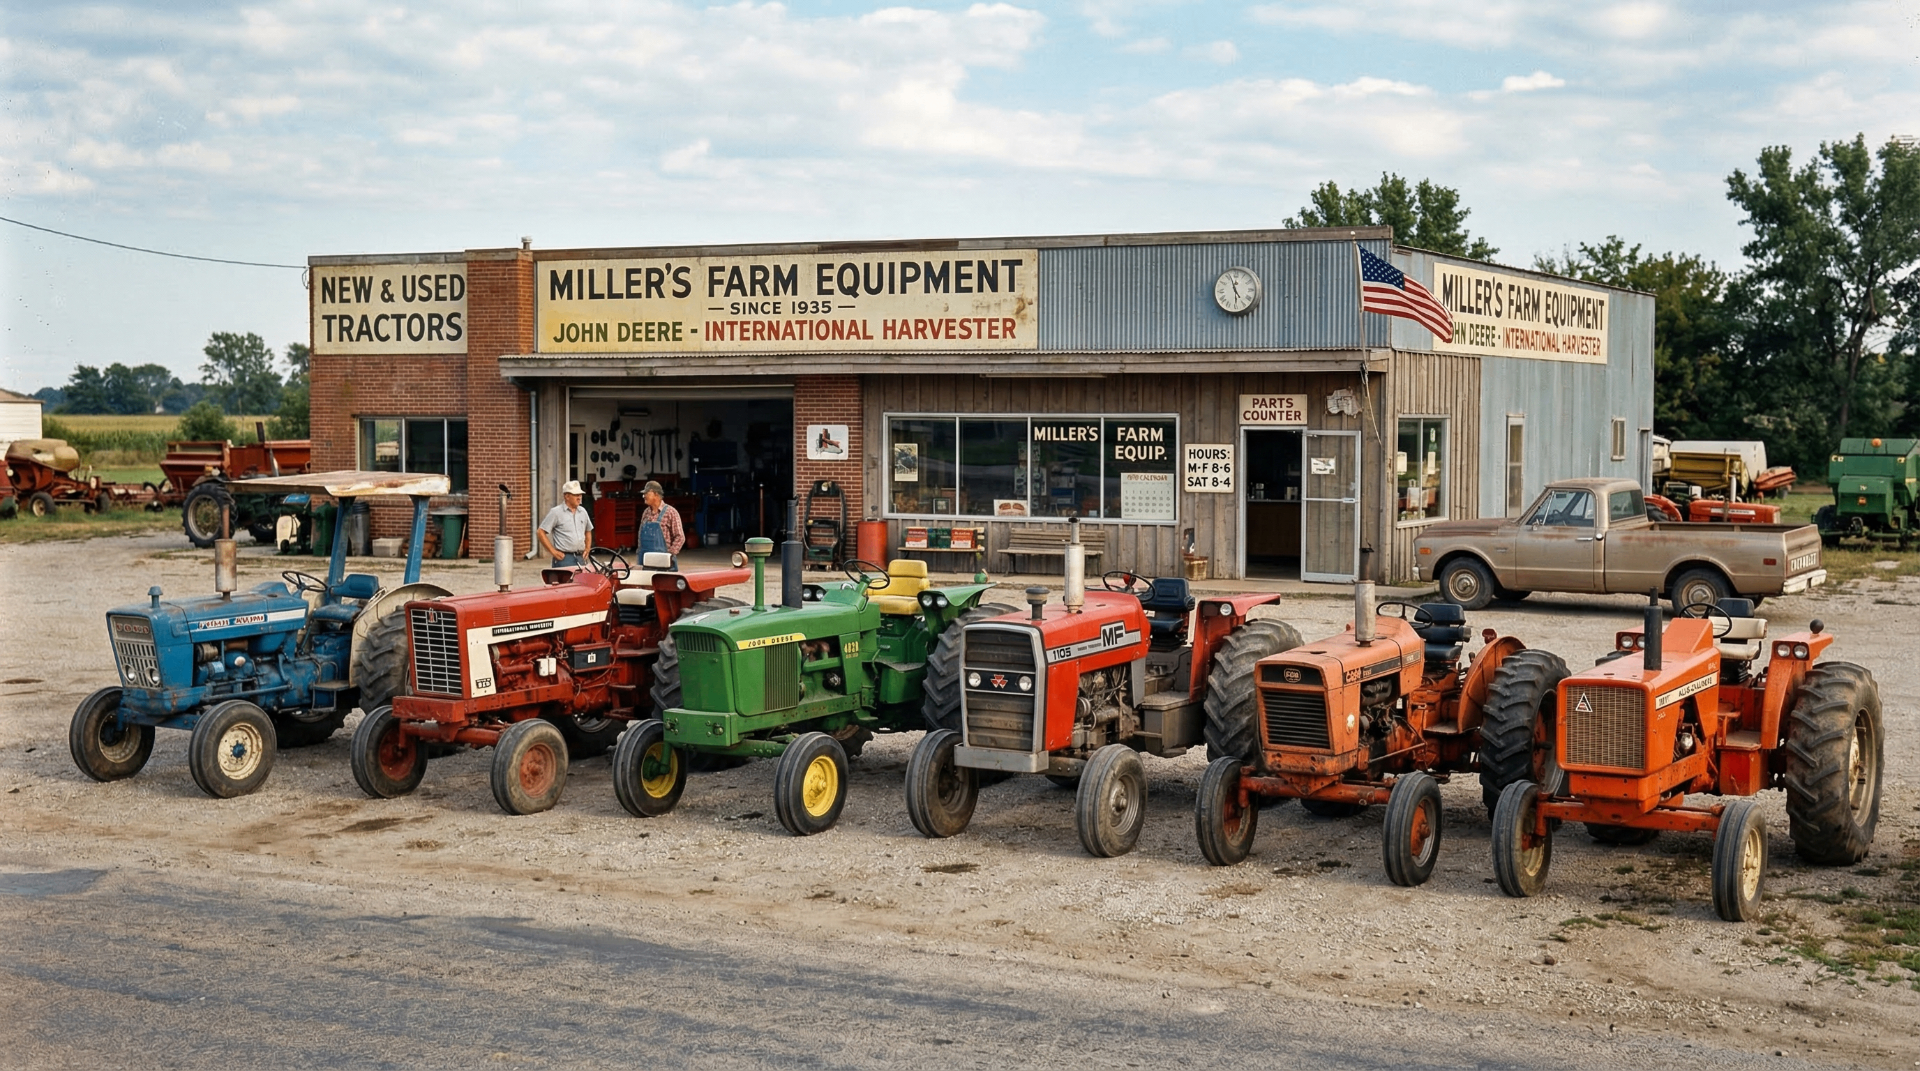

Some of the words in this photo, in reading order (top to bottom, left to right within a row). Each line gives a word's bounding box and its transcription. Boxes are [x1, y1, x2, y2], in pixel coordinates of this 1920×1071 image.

[549, 262, 692, 301] MILLER'S
[708, 263, 798, 298] FARM
[816, 259, 1023, 298] EQUIPMENT
[321, 276, 373, 304] NEW
[380, 279, 395, 303] &
[402, 274, 466, 302] USED
[730, 301, 782, 315] SINCE
[791, 300, 832, 314] 1935
[1442, 272, 1503, 318] MILLER'S
[1508, 284, 1541, 323] FARM
[1545, 290, 1605, 331] EQUIPMENT
[322, 312, 463, 342] TRACTORS
[553, 322, 608, 343] JOHN
[617, 321, 683, 342] DEERE
[705, 318, 874, 342] INTERNATIONAL
[882, 317, 1017, 340] HARVESTER
[1469, 322, 1496, 348] DEERE
[1502, 326, 1560, 354] INTERNATIONAL
[1562, 333, 1601, 357] HARVESTER
[1252, 397, 1294, 409] PARTS
[1242, 410, 1302, 421] COUNTER
[1033, 425, 1099, 442] MILLER'S
[1116, 427, 1164, 442] FARM
[1114, 445, 1168, 462] EQUIP.
[1188, 449, 1230, 460] HOURS:
[1188, 462, 1209, 473] M-F
[1211, 462, 1231, 473] 8-6
[1187, 476, 1209, 487] SAT
[1211, 476, 1231, 487] 8-4
[1102, 625, 1124, 647] MF
[1052, 647, 1072, 660] 1105
